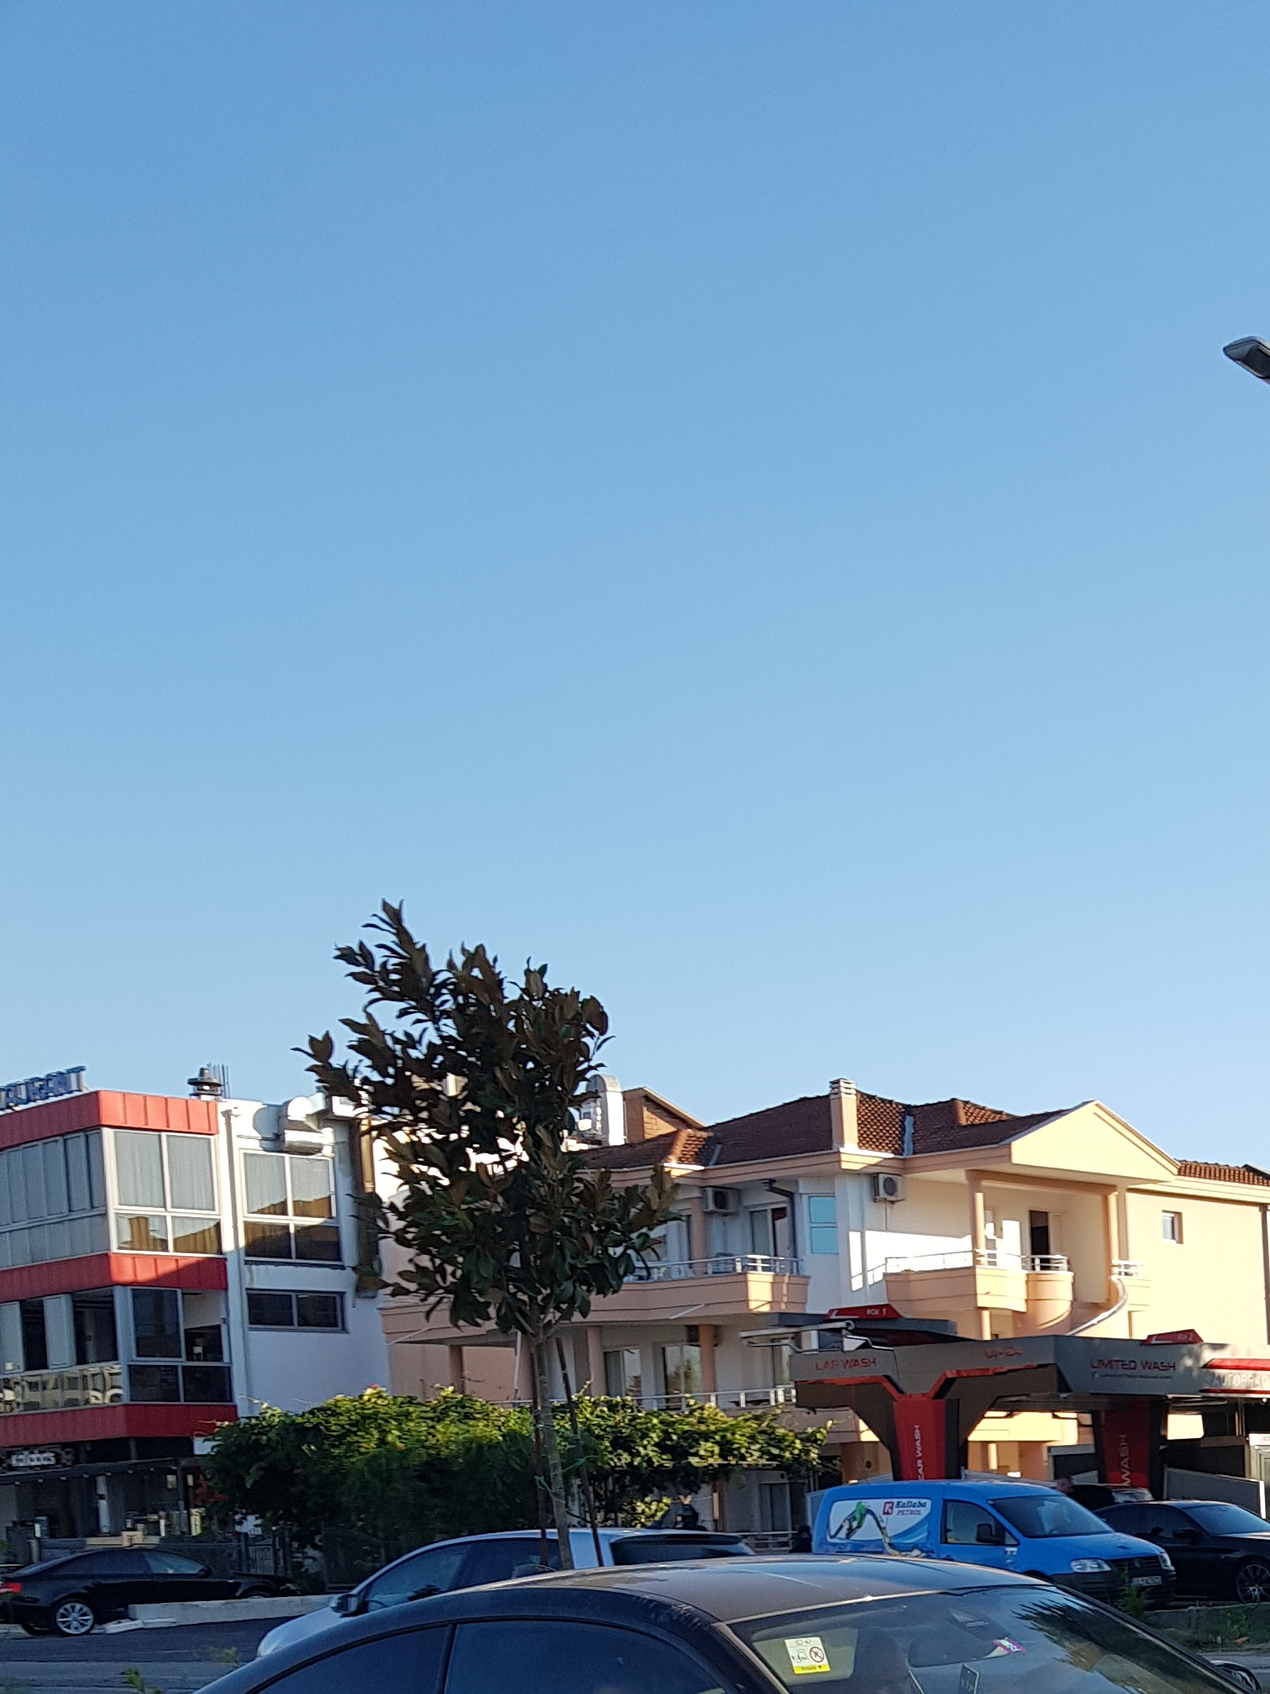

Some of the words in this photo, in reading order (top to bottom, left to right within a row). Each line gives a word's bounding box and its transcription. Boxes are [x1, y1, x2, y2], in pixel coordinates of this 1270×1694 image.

[842, 1357, 876, 1370] WASH
[1090, 1359, 1138, 1371] LIMITED
[1140, 1360, 1176, 1372] WASH
[913, 1425, 922, 1457] WASH
[1119, 1434, 1131, 1487] WASH
